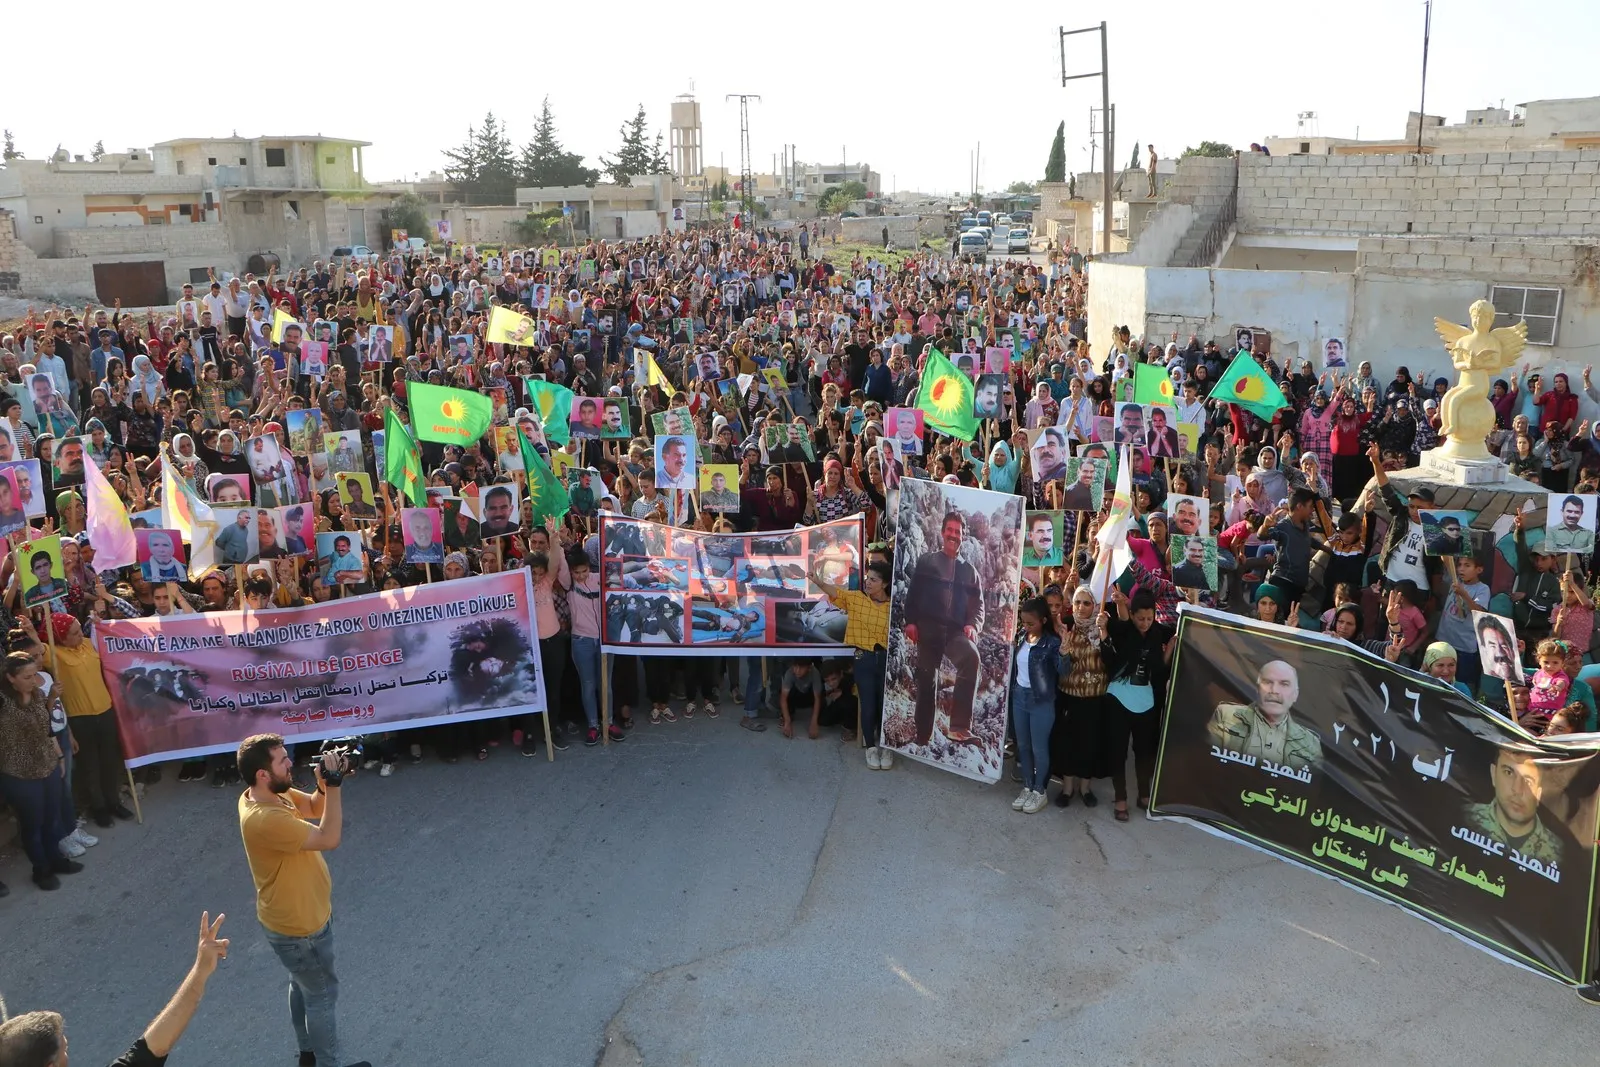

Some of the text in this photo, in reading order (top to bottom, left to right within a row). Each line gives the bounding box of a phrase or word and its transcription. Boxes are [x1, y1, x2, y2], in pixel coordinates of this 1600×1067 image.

[170, 636, 201, 651] AXA
[202, 635, 224, 648] ME
[314, 616, 364, 637] ZAROK
[368, 612, 379, 630] Û
[446, 601, 467, 621] ME
[317, 655, 341, 674] BÊ
[343, 649, 403, 672] DENGE
[189, 695, 236, 713] وكبارنا
[291, 687, 321, 704] تقتل
[367, 679, 397, 696] تحتل
[329, 703, 376, 722] وروسيا
[1210, 744, 1313, 784] شهيد سعيد
[1412, 746, 1455, 782] آب
[1240, 787, 1506, 898] شهداء قصف العدوان التركي
[1450, 824, 1561, 883] شهيد عيسى
[1311, 836, 1410, 888] على شنكال
